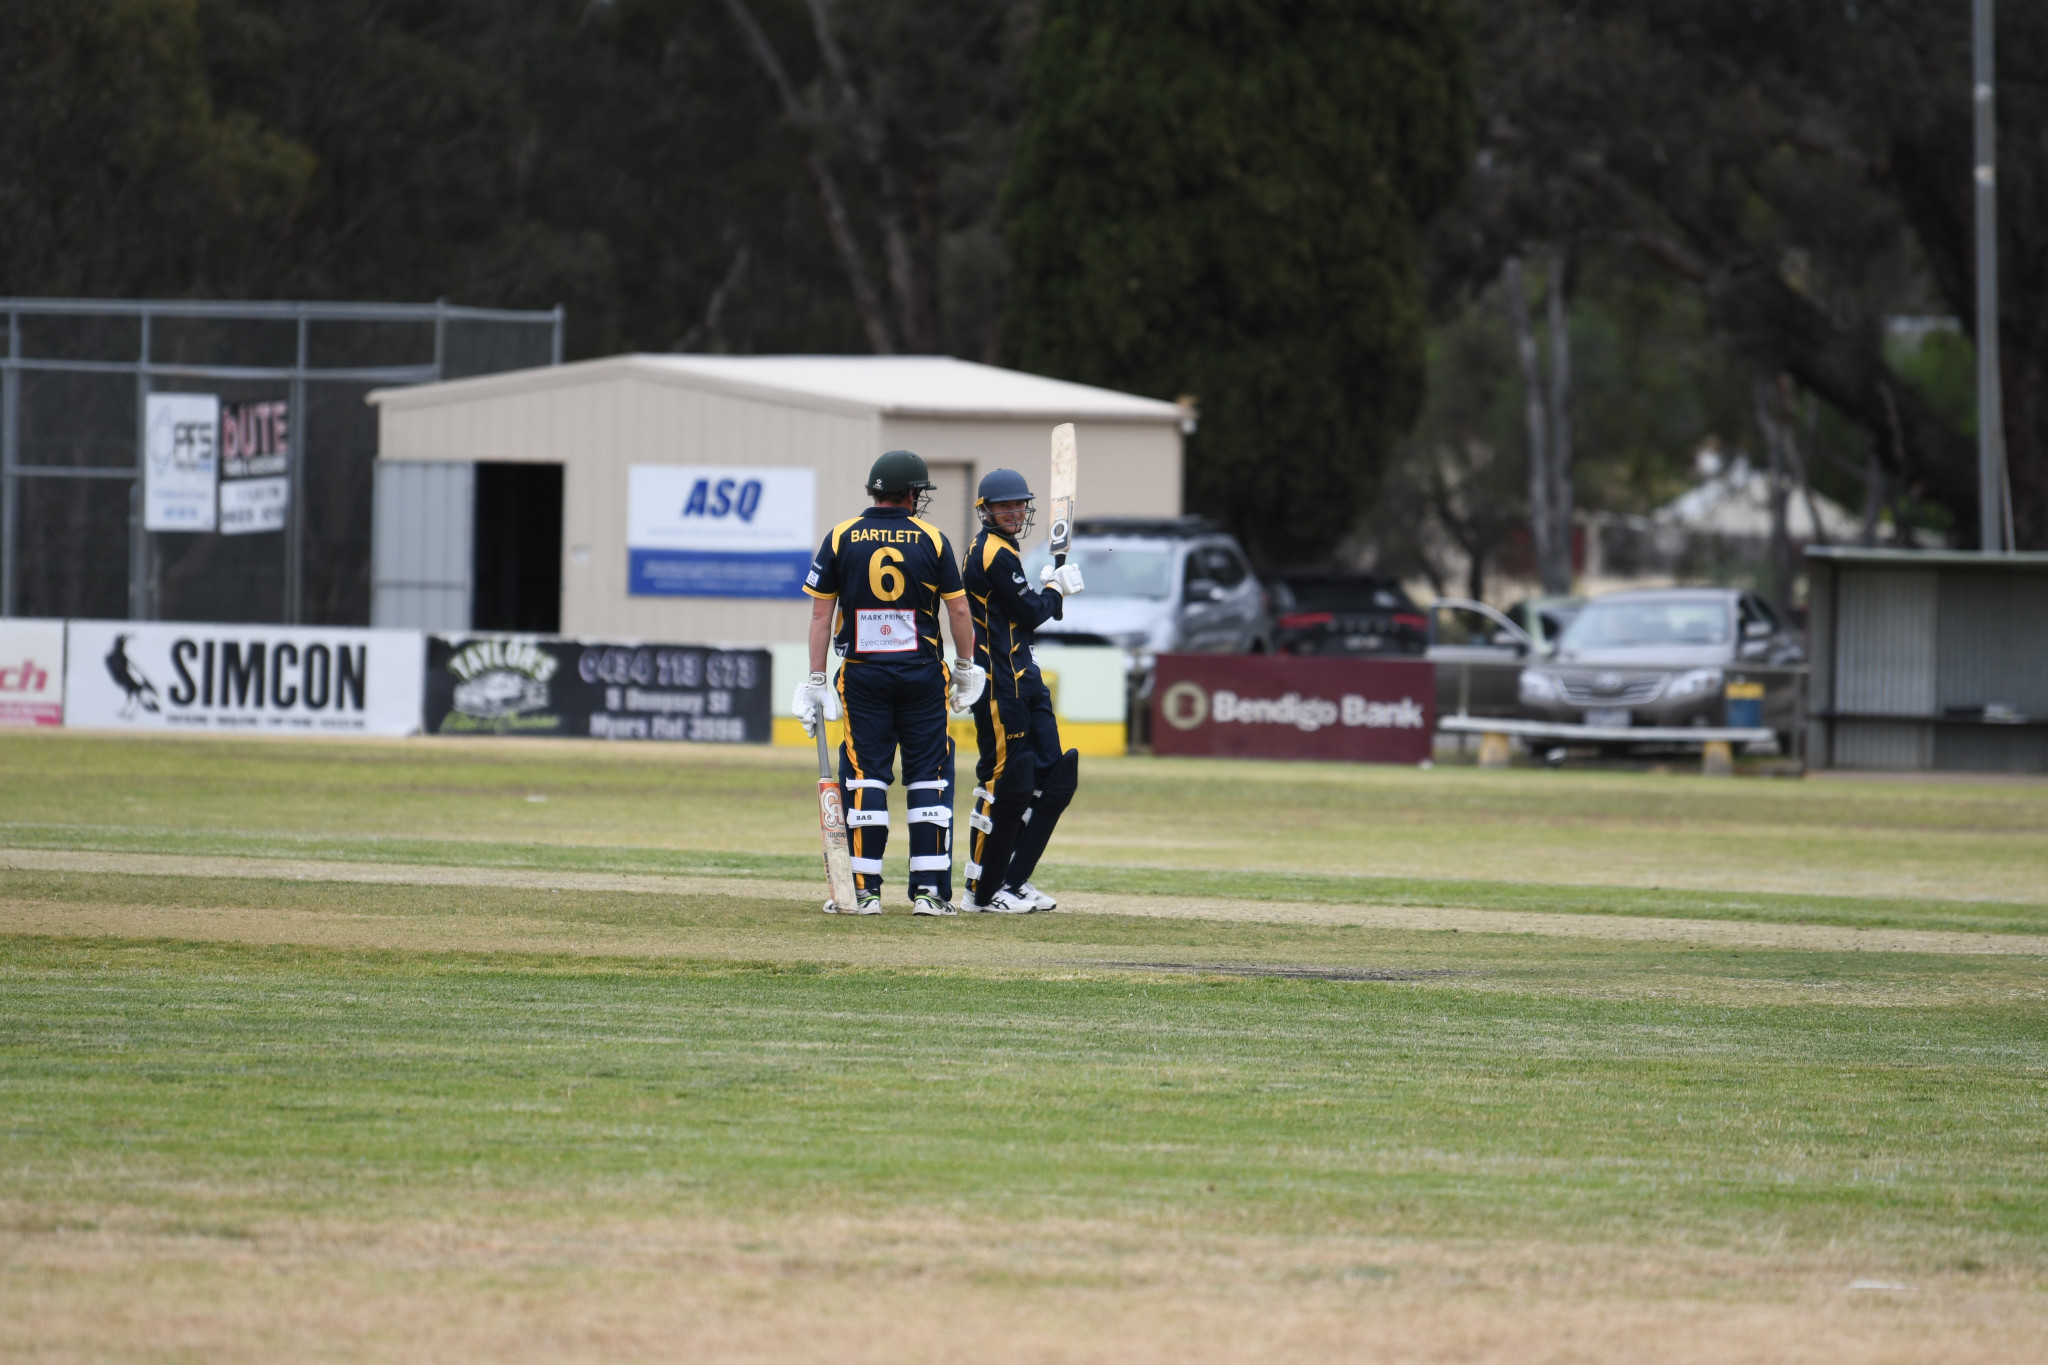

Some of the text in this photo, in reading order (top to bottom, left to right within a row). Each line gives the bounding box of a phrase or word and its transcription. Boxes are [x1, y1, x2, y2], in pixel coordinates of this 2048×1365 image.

[682, 479, 763, 524] ASQ
[850, 528, 921, 544] BARTLETT
[868, 546, 905, 602] 6
[884, 614, 911, 622] PRINCE
[168, 639, 367, 712] SIMCON
[1212, 691, 1425, 731] Bendigo Bank
